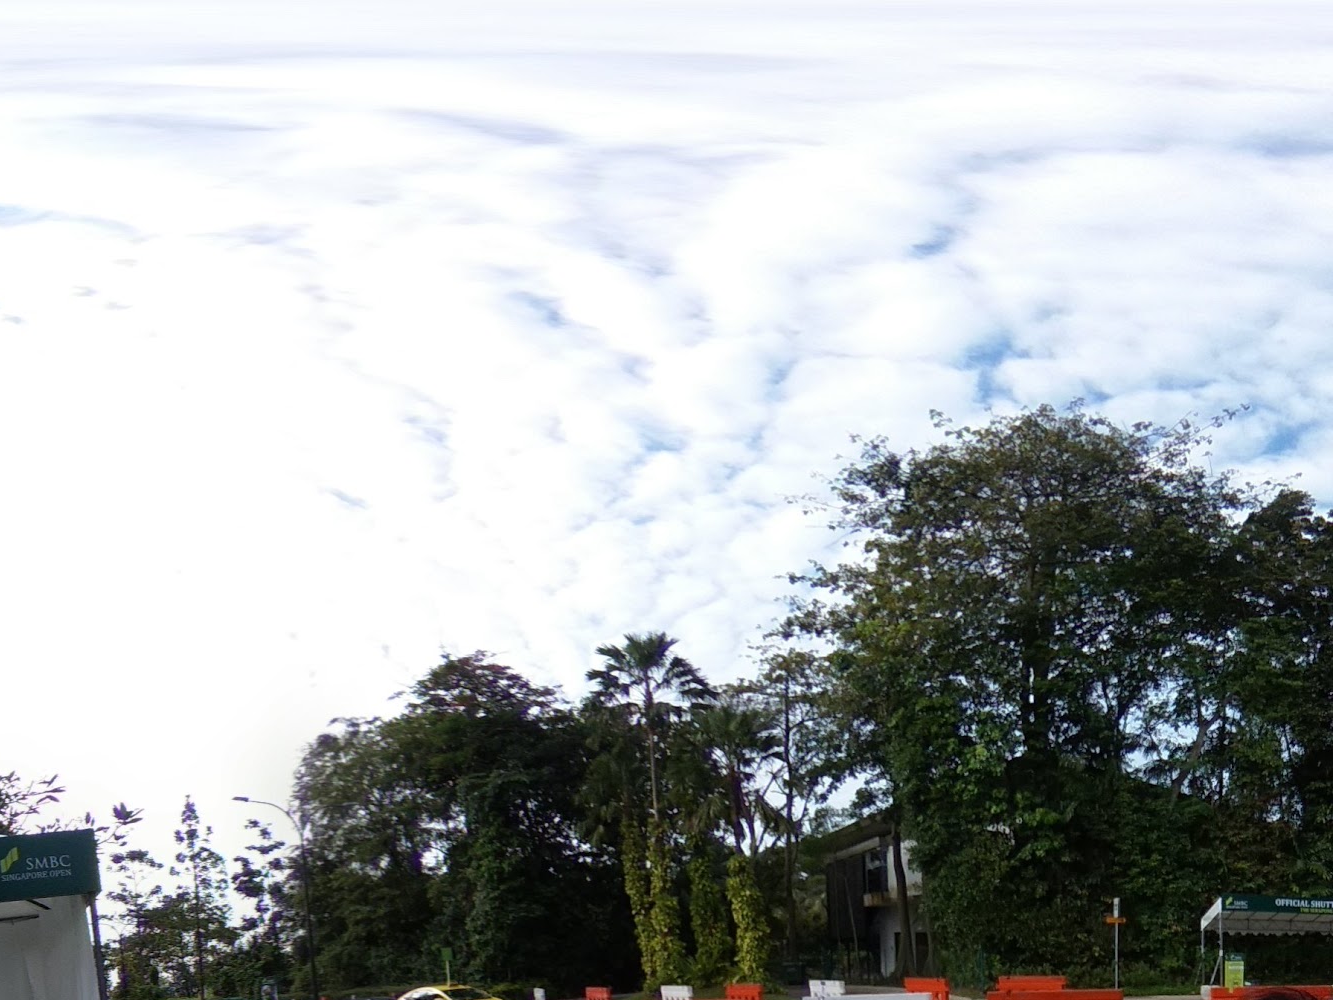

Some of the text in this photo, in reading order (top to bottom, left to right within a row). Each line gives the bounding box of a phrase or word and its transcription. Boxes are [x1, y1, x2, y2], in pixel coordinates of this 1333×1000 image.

[26, 854, 71, 870] SMBC
[1, 869, 72, 881] SINGAPORE OPEN
[1275, 898, 1309, 907] OFFICIAL
